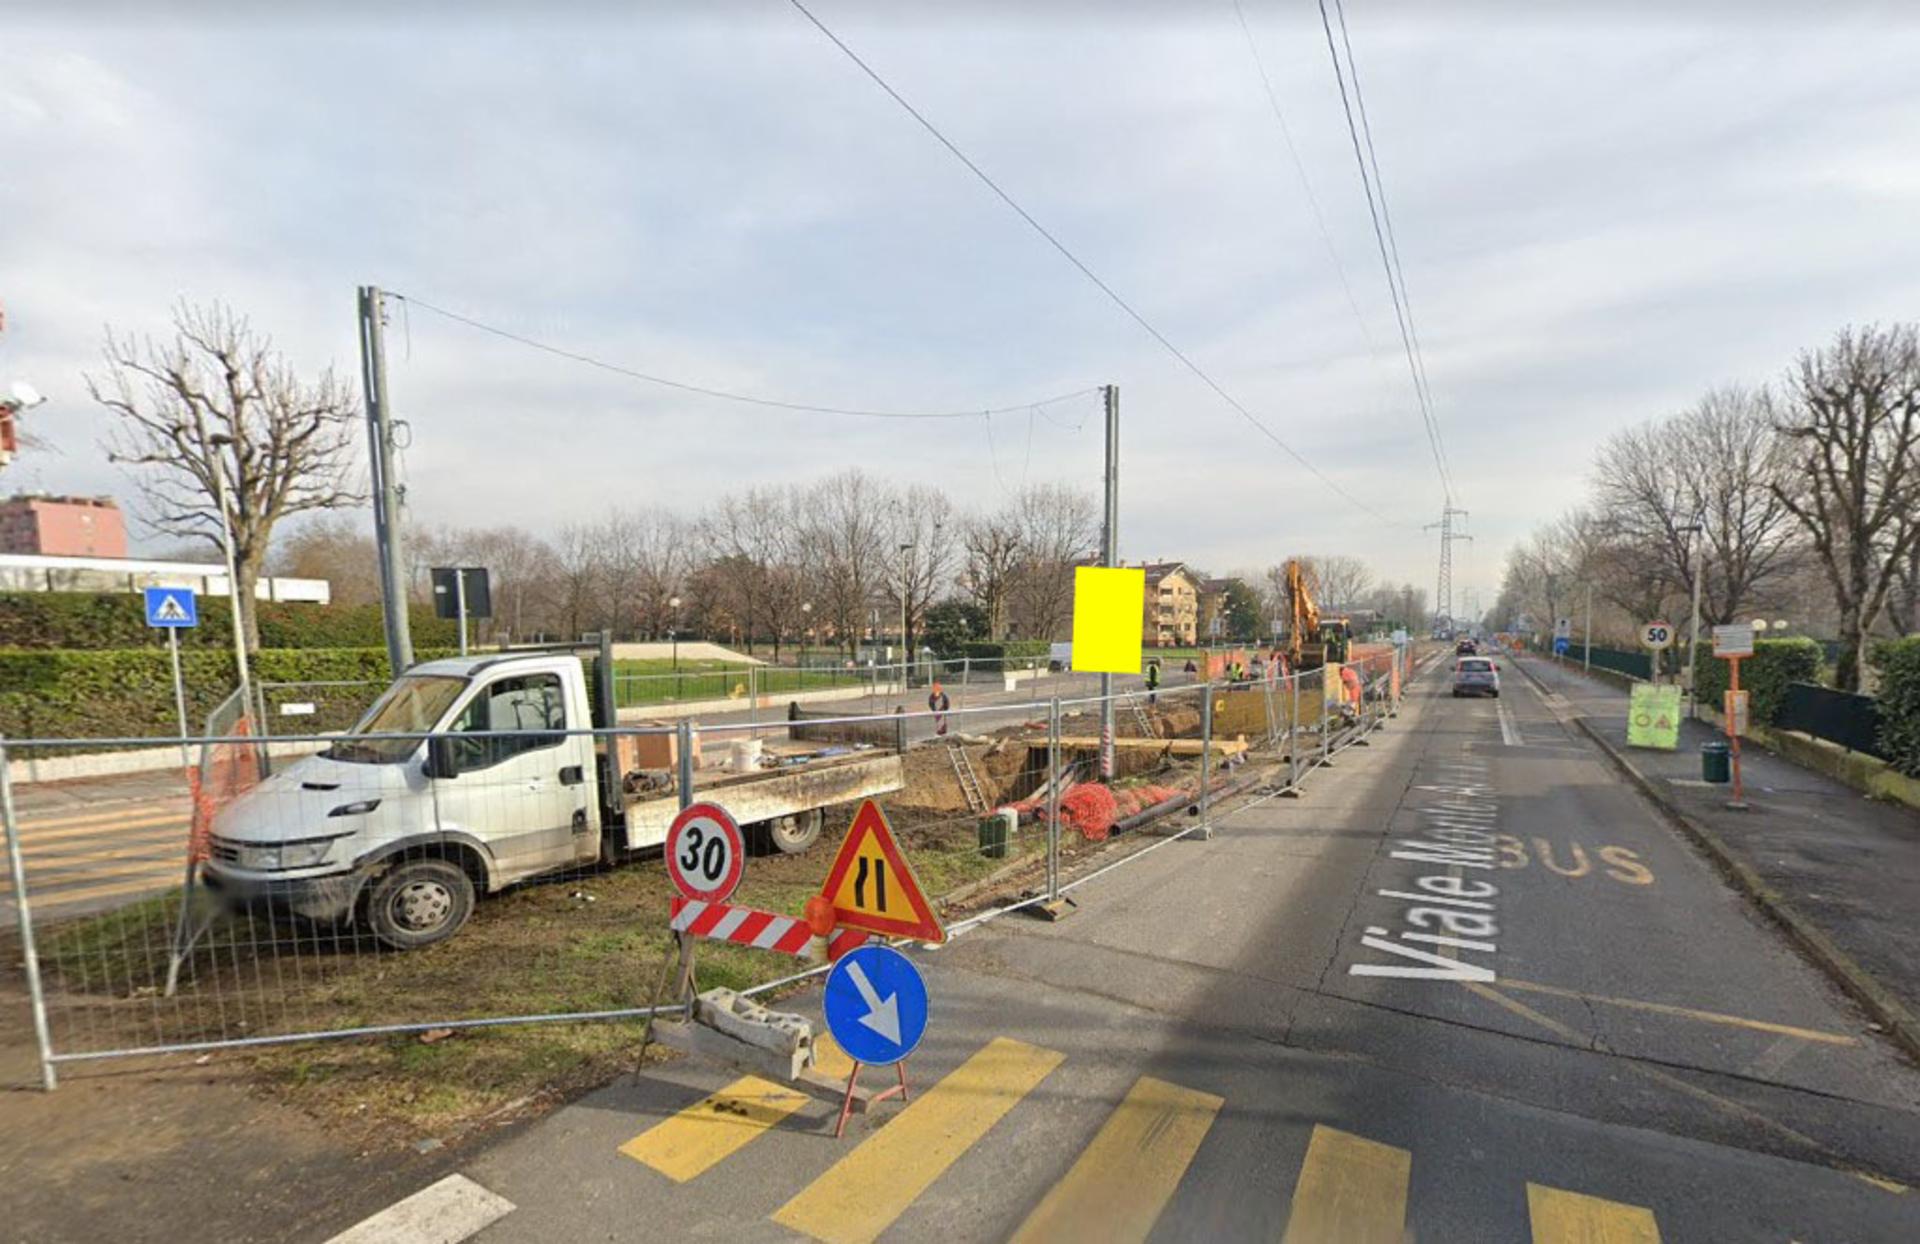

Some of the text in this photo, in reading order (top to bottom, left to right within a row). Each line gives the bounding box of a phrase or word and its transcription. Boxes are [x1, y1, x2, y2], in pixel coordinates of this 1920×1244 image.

[1648, 628, 1667, 641] 50
[680, 827, 726, 881] 30
[1490, 833, 1654, 885] BUS
